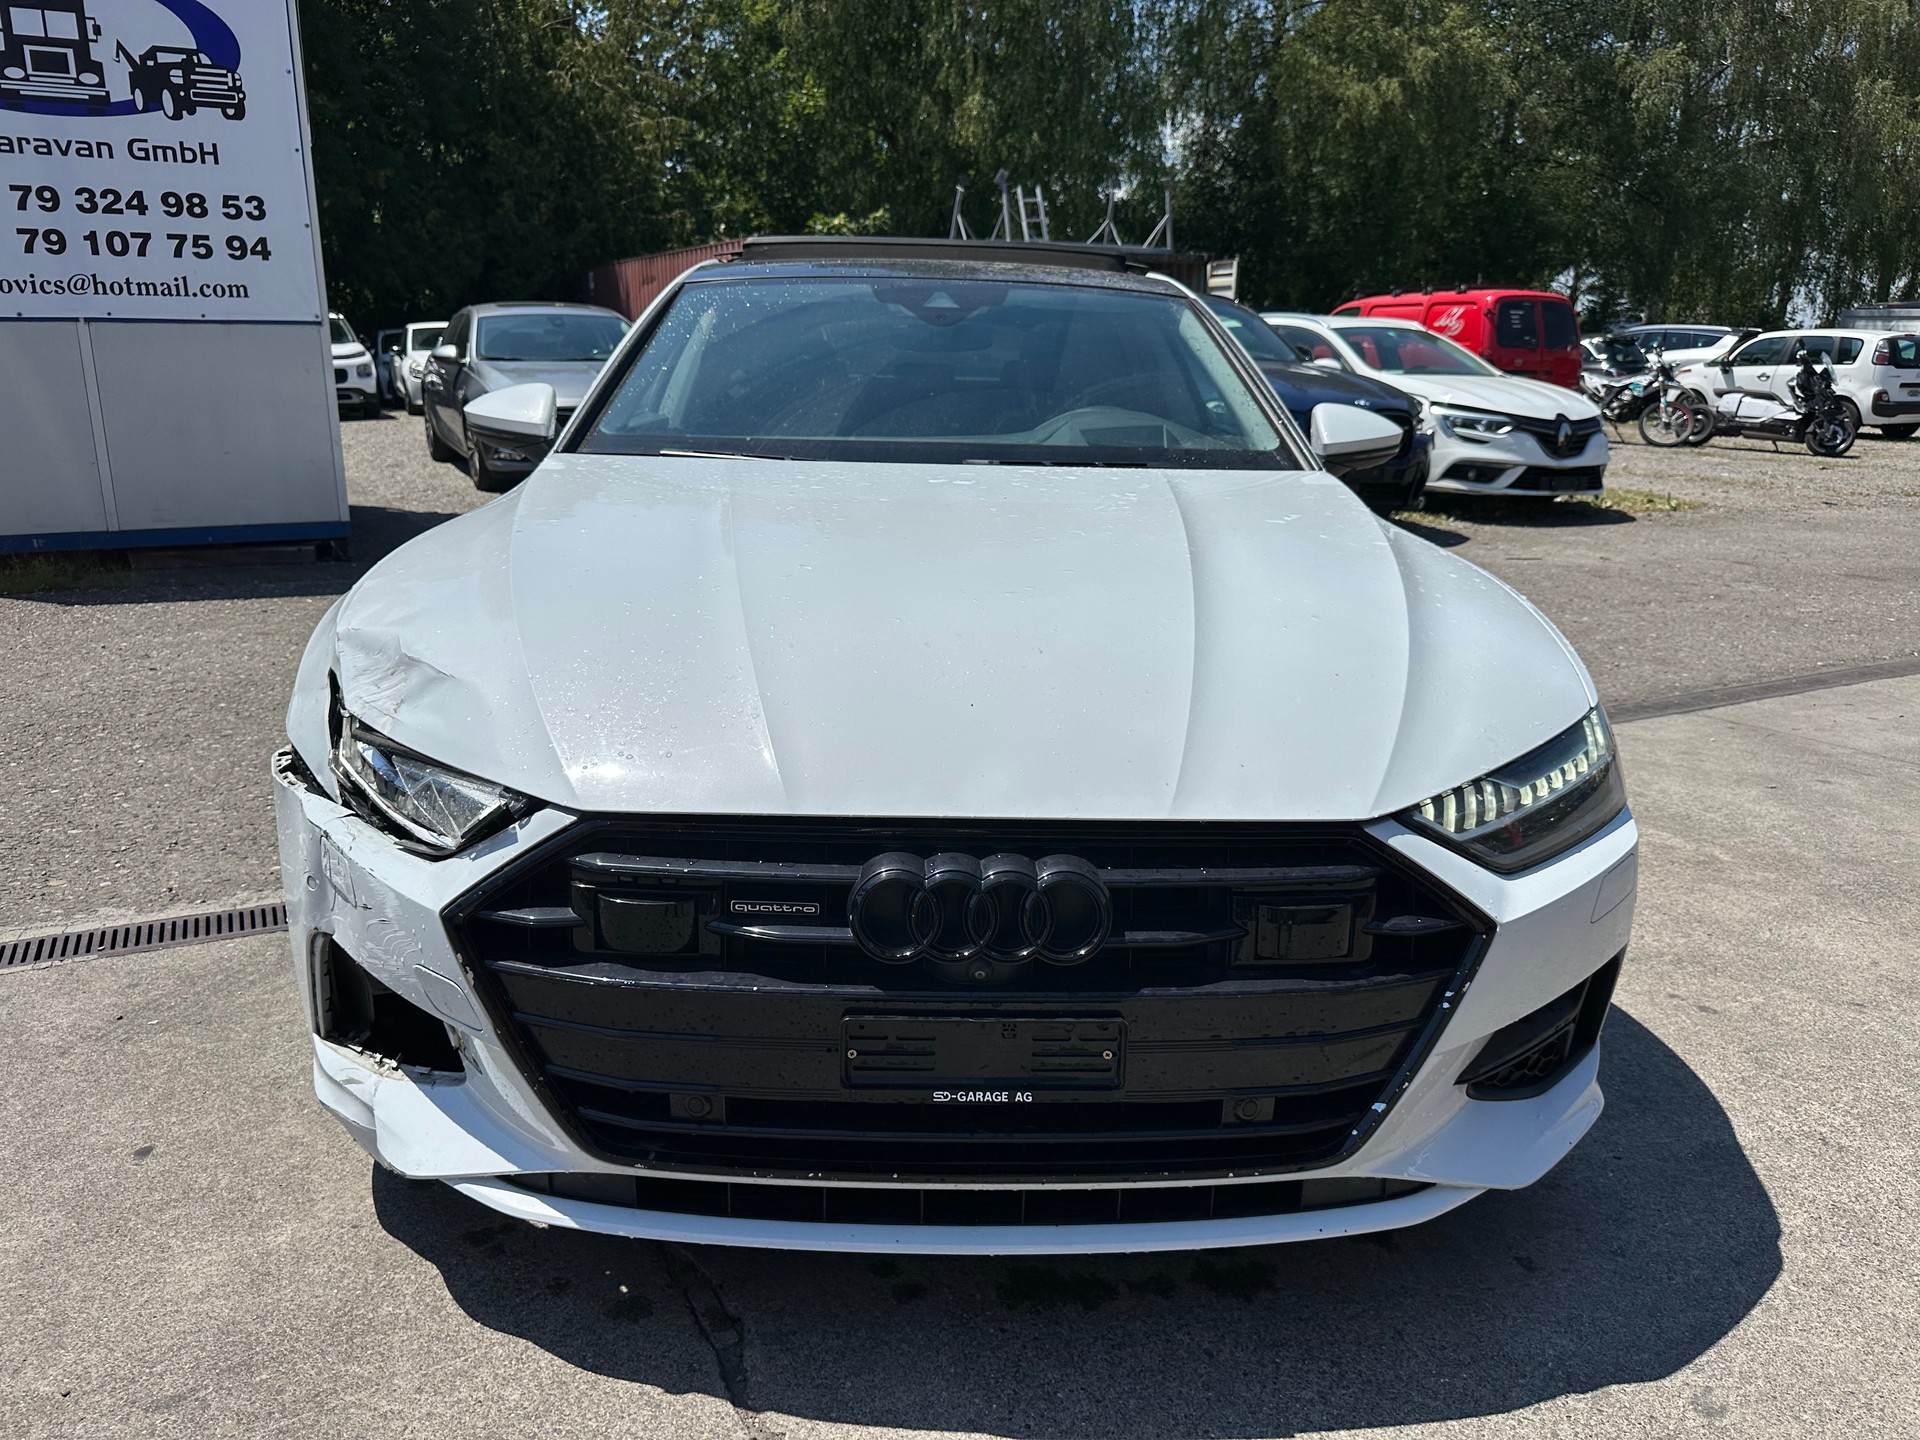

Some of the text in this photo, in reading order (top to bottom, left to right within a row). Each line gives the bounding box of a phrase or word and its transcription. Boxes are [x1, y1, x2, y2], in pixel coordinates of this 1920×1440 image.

[0, 135, 220, 165] aravan GmbH
[9, 184, 267, 221] 79 324 98 53
[16, 228, 272, 262] 79 107 75 94
[0, 273, 250, 299] ovics@hotmail.com
[734, 904, 816, 913] quattro
[933, 1091, 1033, 1102] SD-GARAGE AG
